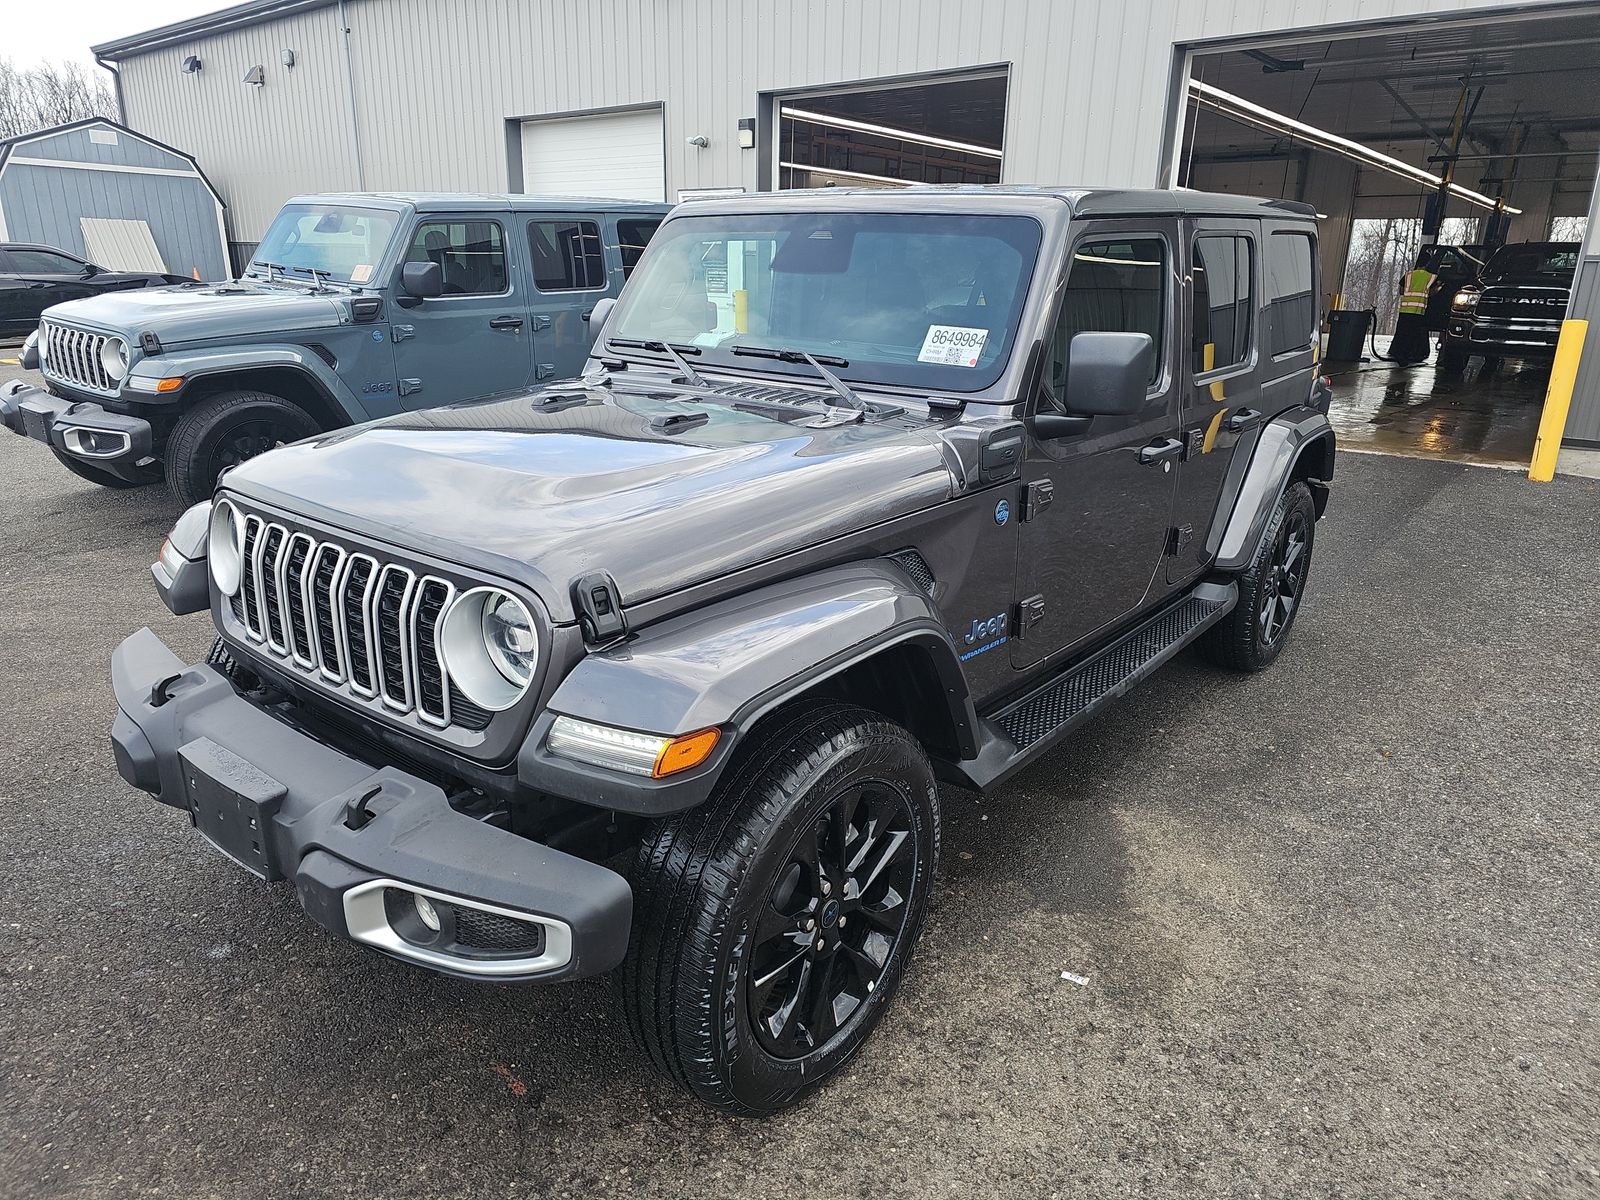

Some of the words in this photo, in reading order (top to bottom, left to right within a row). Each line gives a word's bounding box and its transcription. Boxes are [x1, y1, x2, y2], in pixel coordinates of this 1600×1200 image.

[1505, 297, 1545, 305] RAM
[931, 329, 986, 348] 8649984
[362, 380, 393, 393] Jeep
[964, 612, 1008, 645] Jeep
[723, 933, 749, 1052] NEXEN
